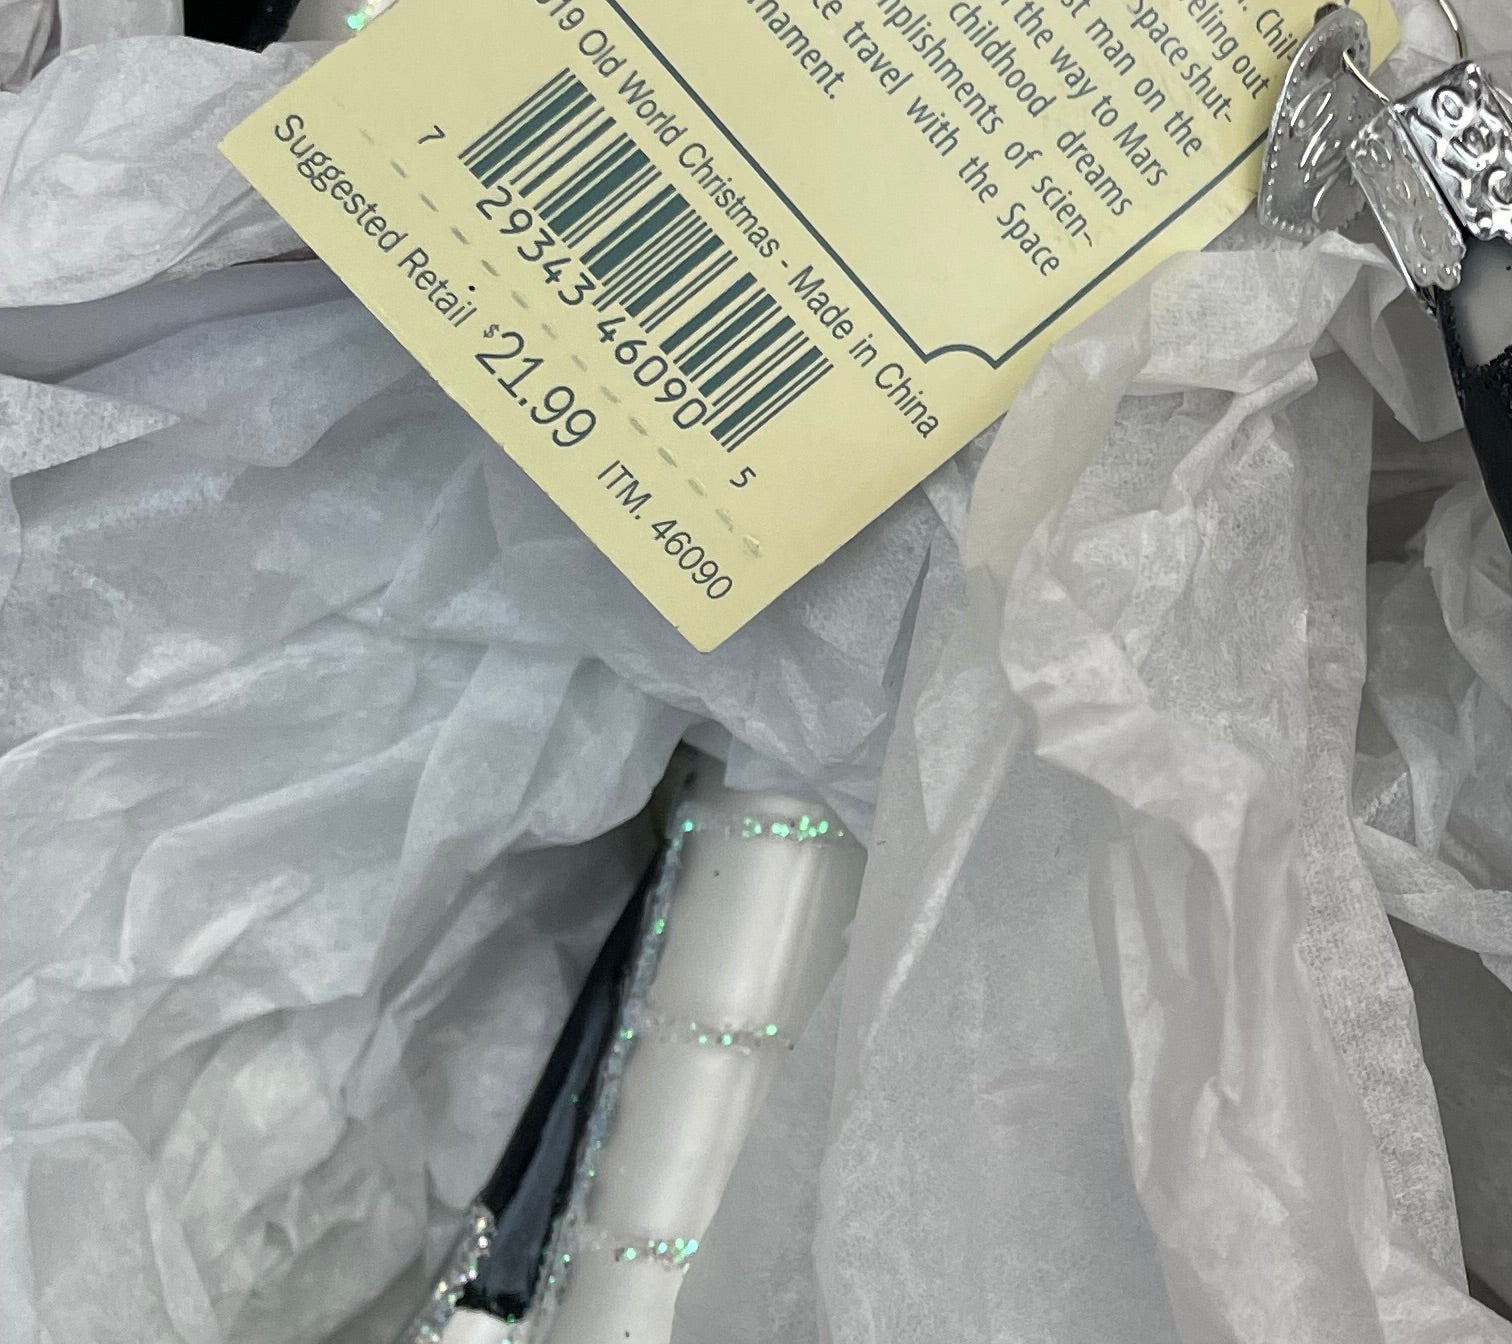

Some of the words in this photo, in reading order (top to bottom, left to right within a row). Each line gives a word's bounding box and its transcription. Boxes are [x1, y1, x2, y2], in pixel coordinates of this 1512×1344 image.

[842, 20, 915, 96] travel
[906, 95, 961, 157] with
[958, 155, 999, 205] the
[996, 202, 1060, 277] Space
[949, 2, 1057, 118] childhood
[1056, 130, 1133, 217] dreams
[1013, 0, 1054, 50] the
[1049, 45, 1098, 100] way
[1091, 94, 1119, 128] to
[1112, 121, 1168, 187] Mars
[1084, 17, 1136, 77] man
[1133, 77, 1166, 113] on
[1163, 110, 1203, 158] the
[1180, 63, 1232, 123] shut-
[1231, 54, 1270, 100] out
[578, 29, 628, 78] Old
[617, 69, 689, 147] World
[678, 142, 781, 258] Christmas
[787, 264, 854, 340] Made
[848, 332, 878, 368] in
[874, 362, 939, 439] China
[1004, 141, 1043, 171] of
[1031, 175, 1093, 248] scien-
[274, 114, 409, 254] Suggested
[396, 246, 478, 328] Retail
[597, 459, 653, 521] ITM.
[650, 519, 733, 600] 46090
[417, 124, 446, 145] 7
[475, 185, 597, 306] 29343
[596, 316, 708, 430] 46090
[729, 465, 757, 488] 5
